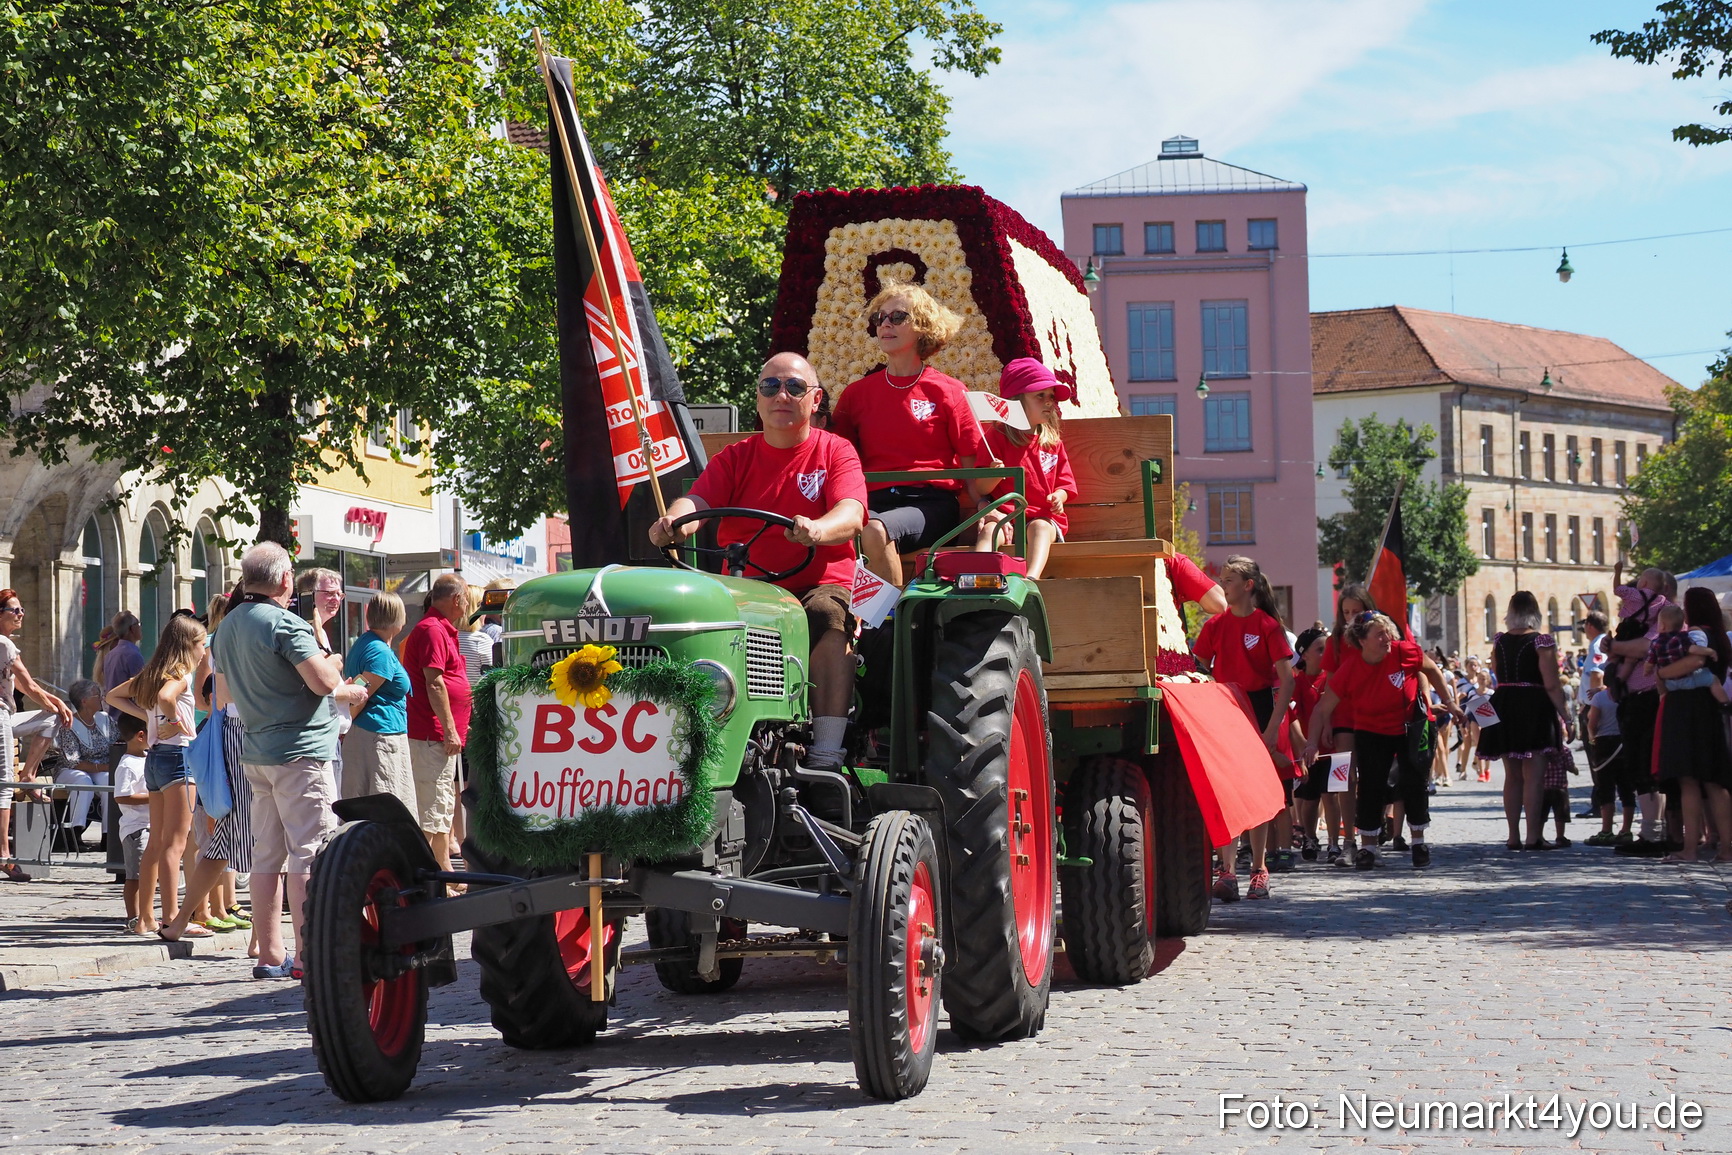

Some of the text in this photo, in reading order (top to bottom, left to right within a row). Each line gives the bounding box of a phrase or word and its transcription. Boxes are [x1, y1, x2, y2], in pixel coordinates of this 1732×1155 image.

[543, 618, 649, 643] FENDT
[531, 700, 659, 754] BSC
[508, 767, 683, 818] Woffenbach
